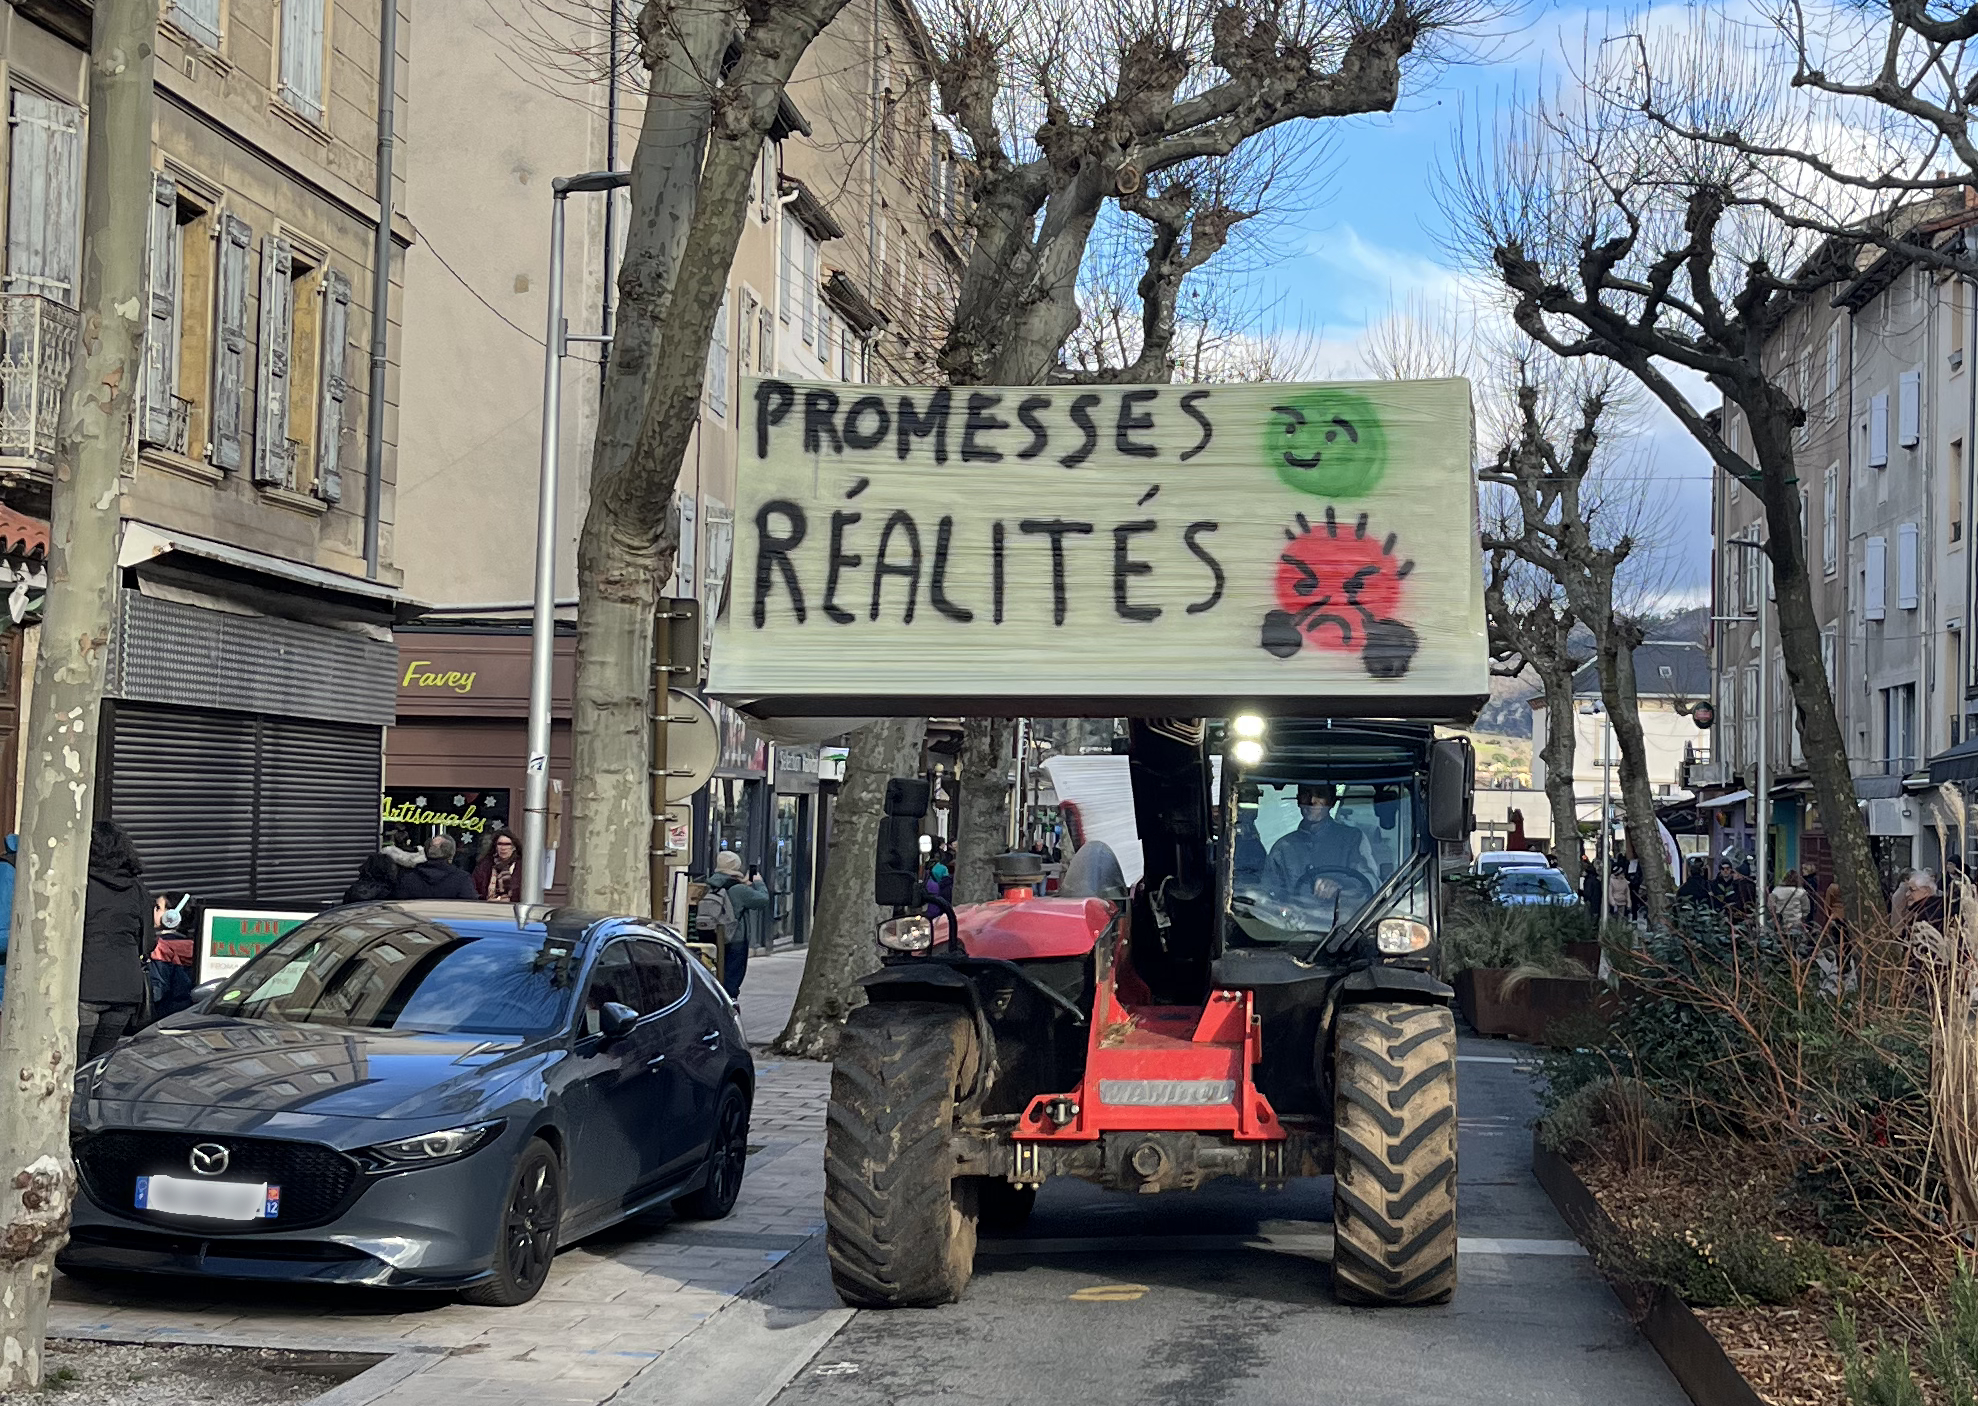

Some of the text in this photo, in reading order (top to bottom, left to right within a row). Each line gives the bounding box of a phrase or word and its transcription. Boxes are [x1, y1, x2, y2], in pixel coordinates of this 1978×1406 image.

[755, 379, 1213, 468] PROMESSES
[753, 477, 1226, 628] RÉALITÉS
[402, 661, 477, 693] Favey
[383, 797, 487, 833] Artisanales
[210, 942, 269, 956] PAST
[266, 1202, 278, 1213] 12
